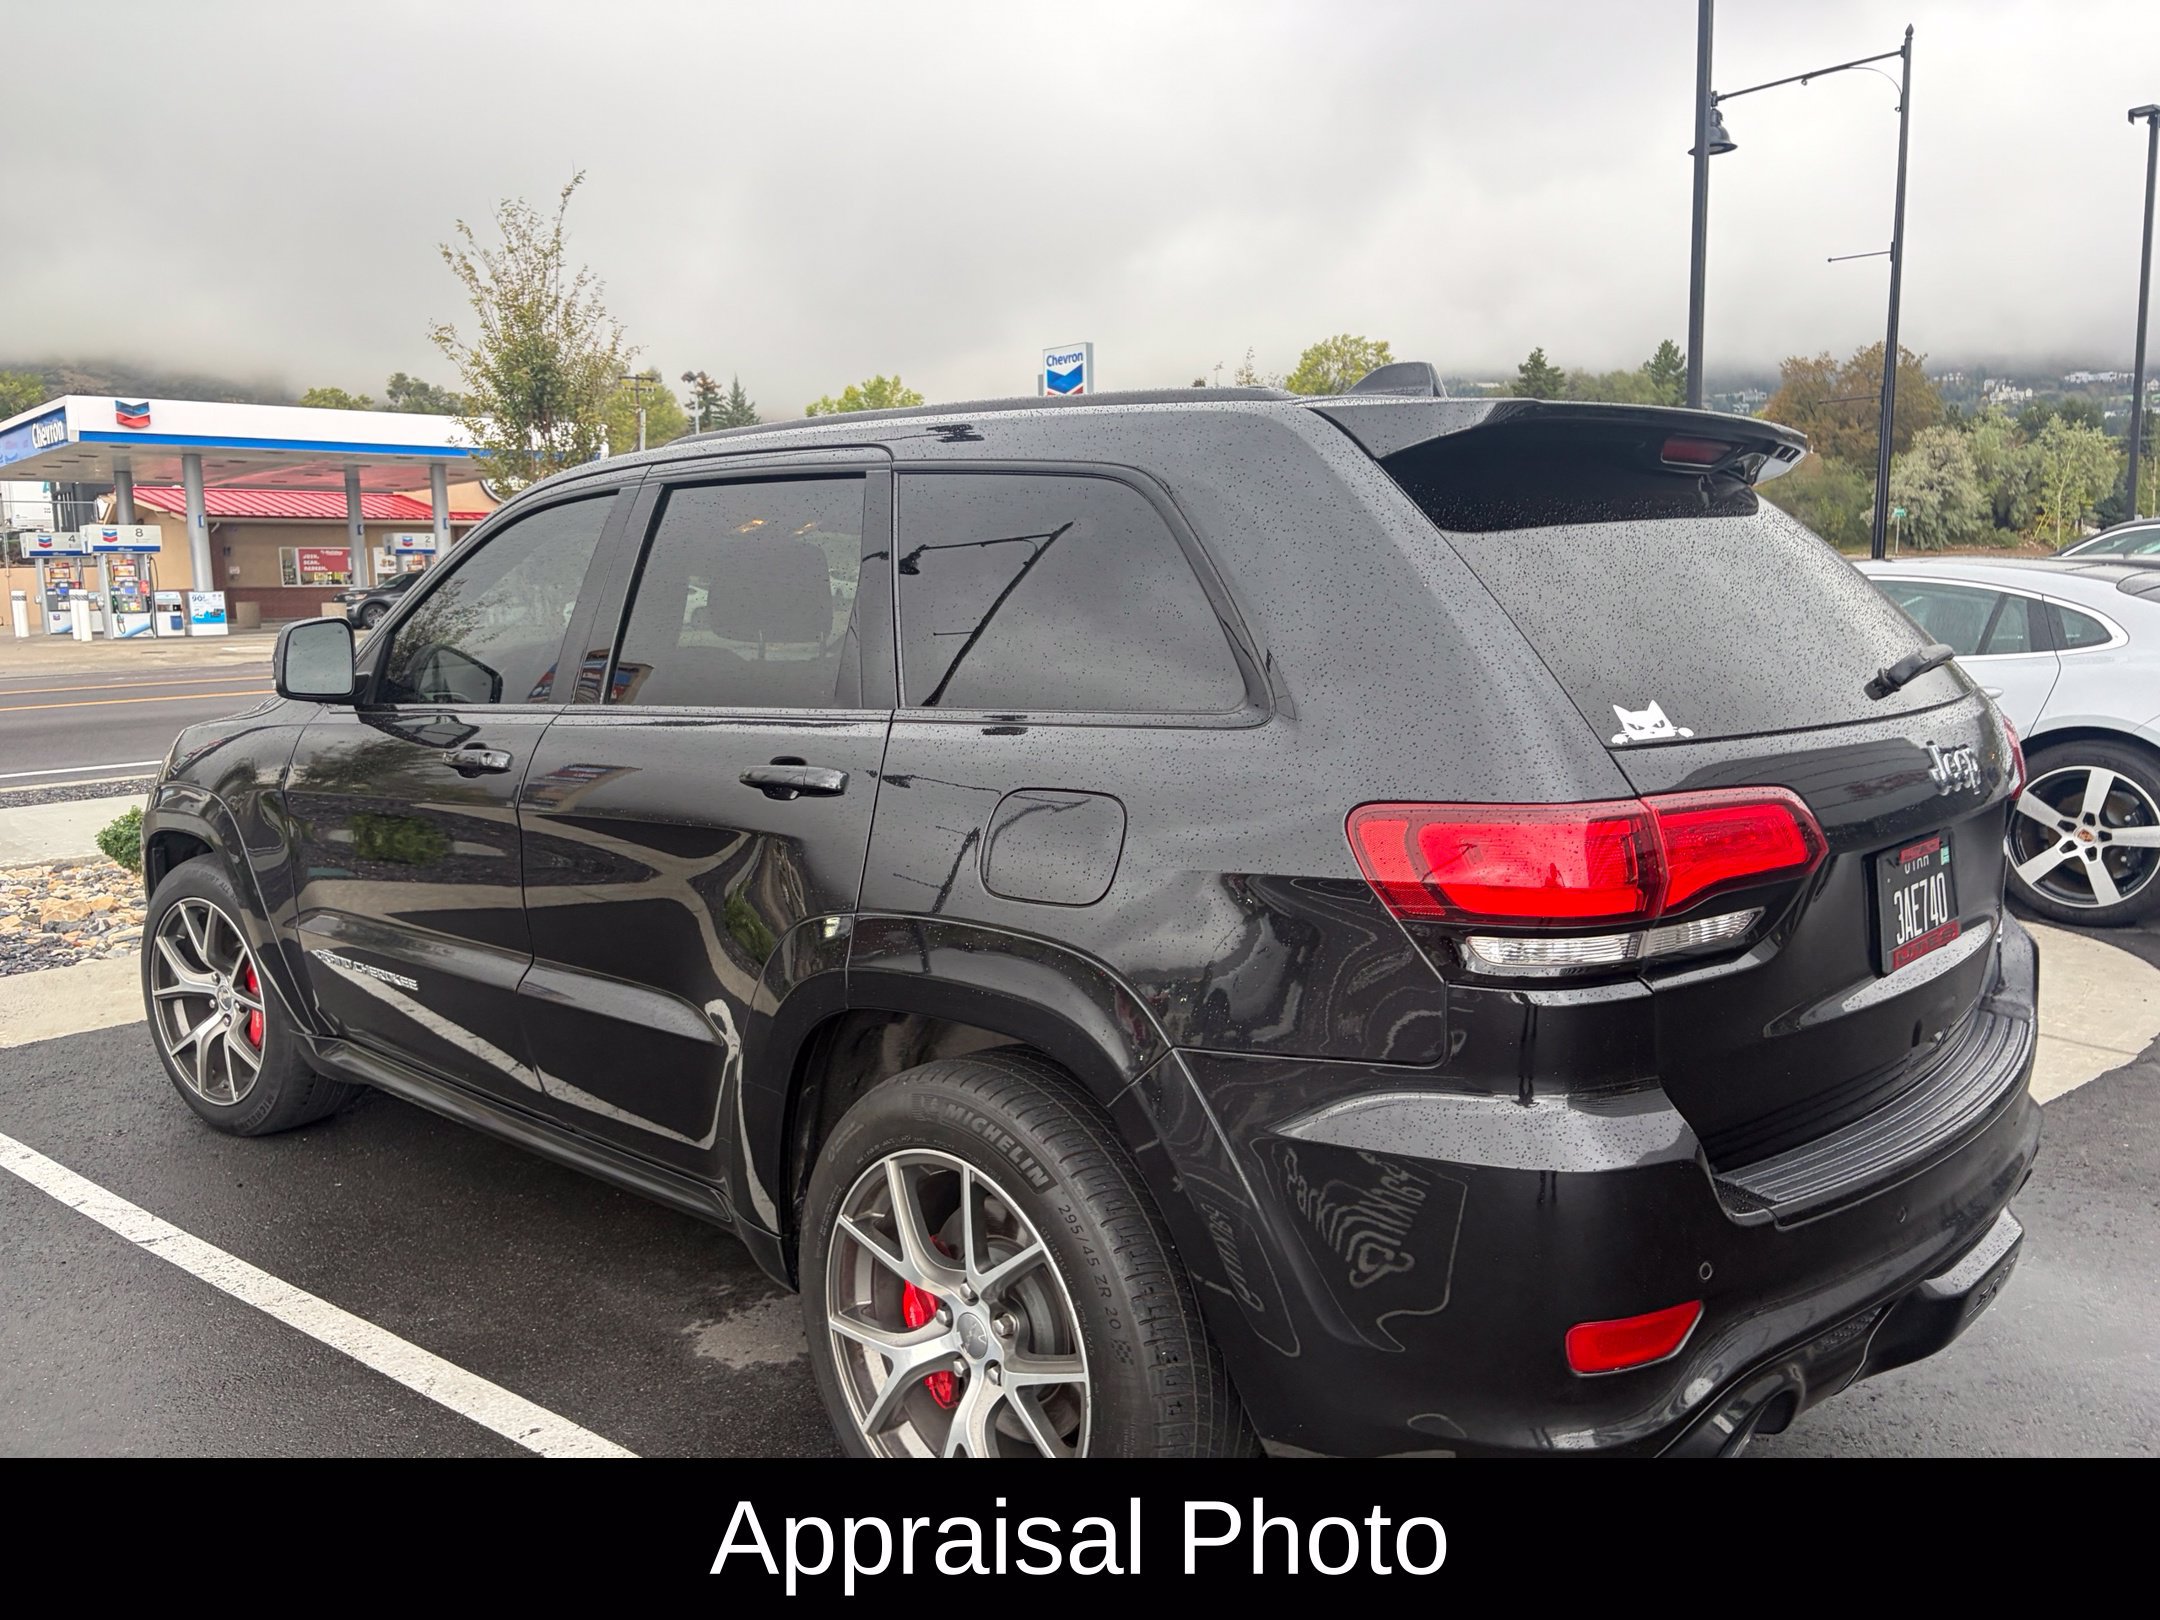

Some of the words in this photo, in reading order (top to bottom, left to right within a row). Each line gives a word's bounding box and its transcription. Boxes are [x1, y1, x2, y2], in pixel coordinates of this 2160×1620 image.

[1046, 351, 1084, 367] Chevron
[31, 420, 65, 449] Chevron
[68, 535, 76, 543] 4
[135, 528, 144, 537] 8
[424, 535, 431, 543] 2
[1928, 744, 1981, 796] Jeep
[1893, 872, 1948, 945] 3AE740
[353, 960, 419, 991] CHEROKEE
[943, 1102, 1050, 1188] MICHELIN
[1058, 1203, 1101, 1267] 295/45
[1094, 1274, 1113, 1299] ZR
[1105, 1307, 1122, 1330] 20
